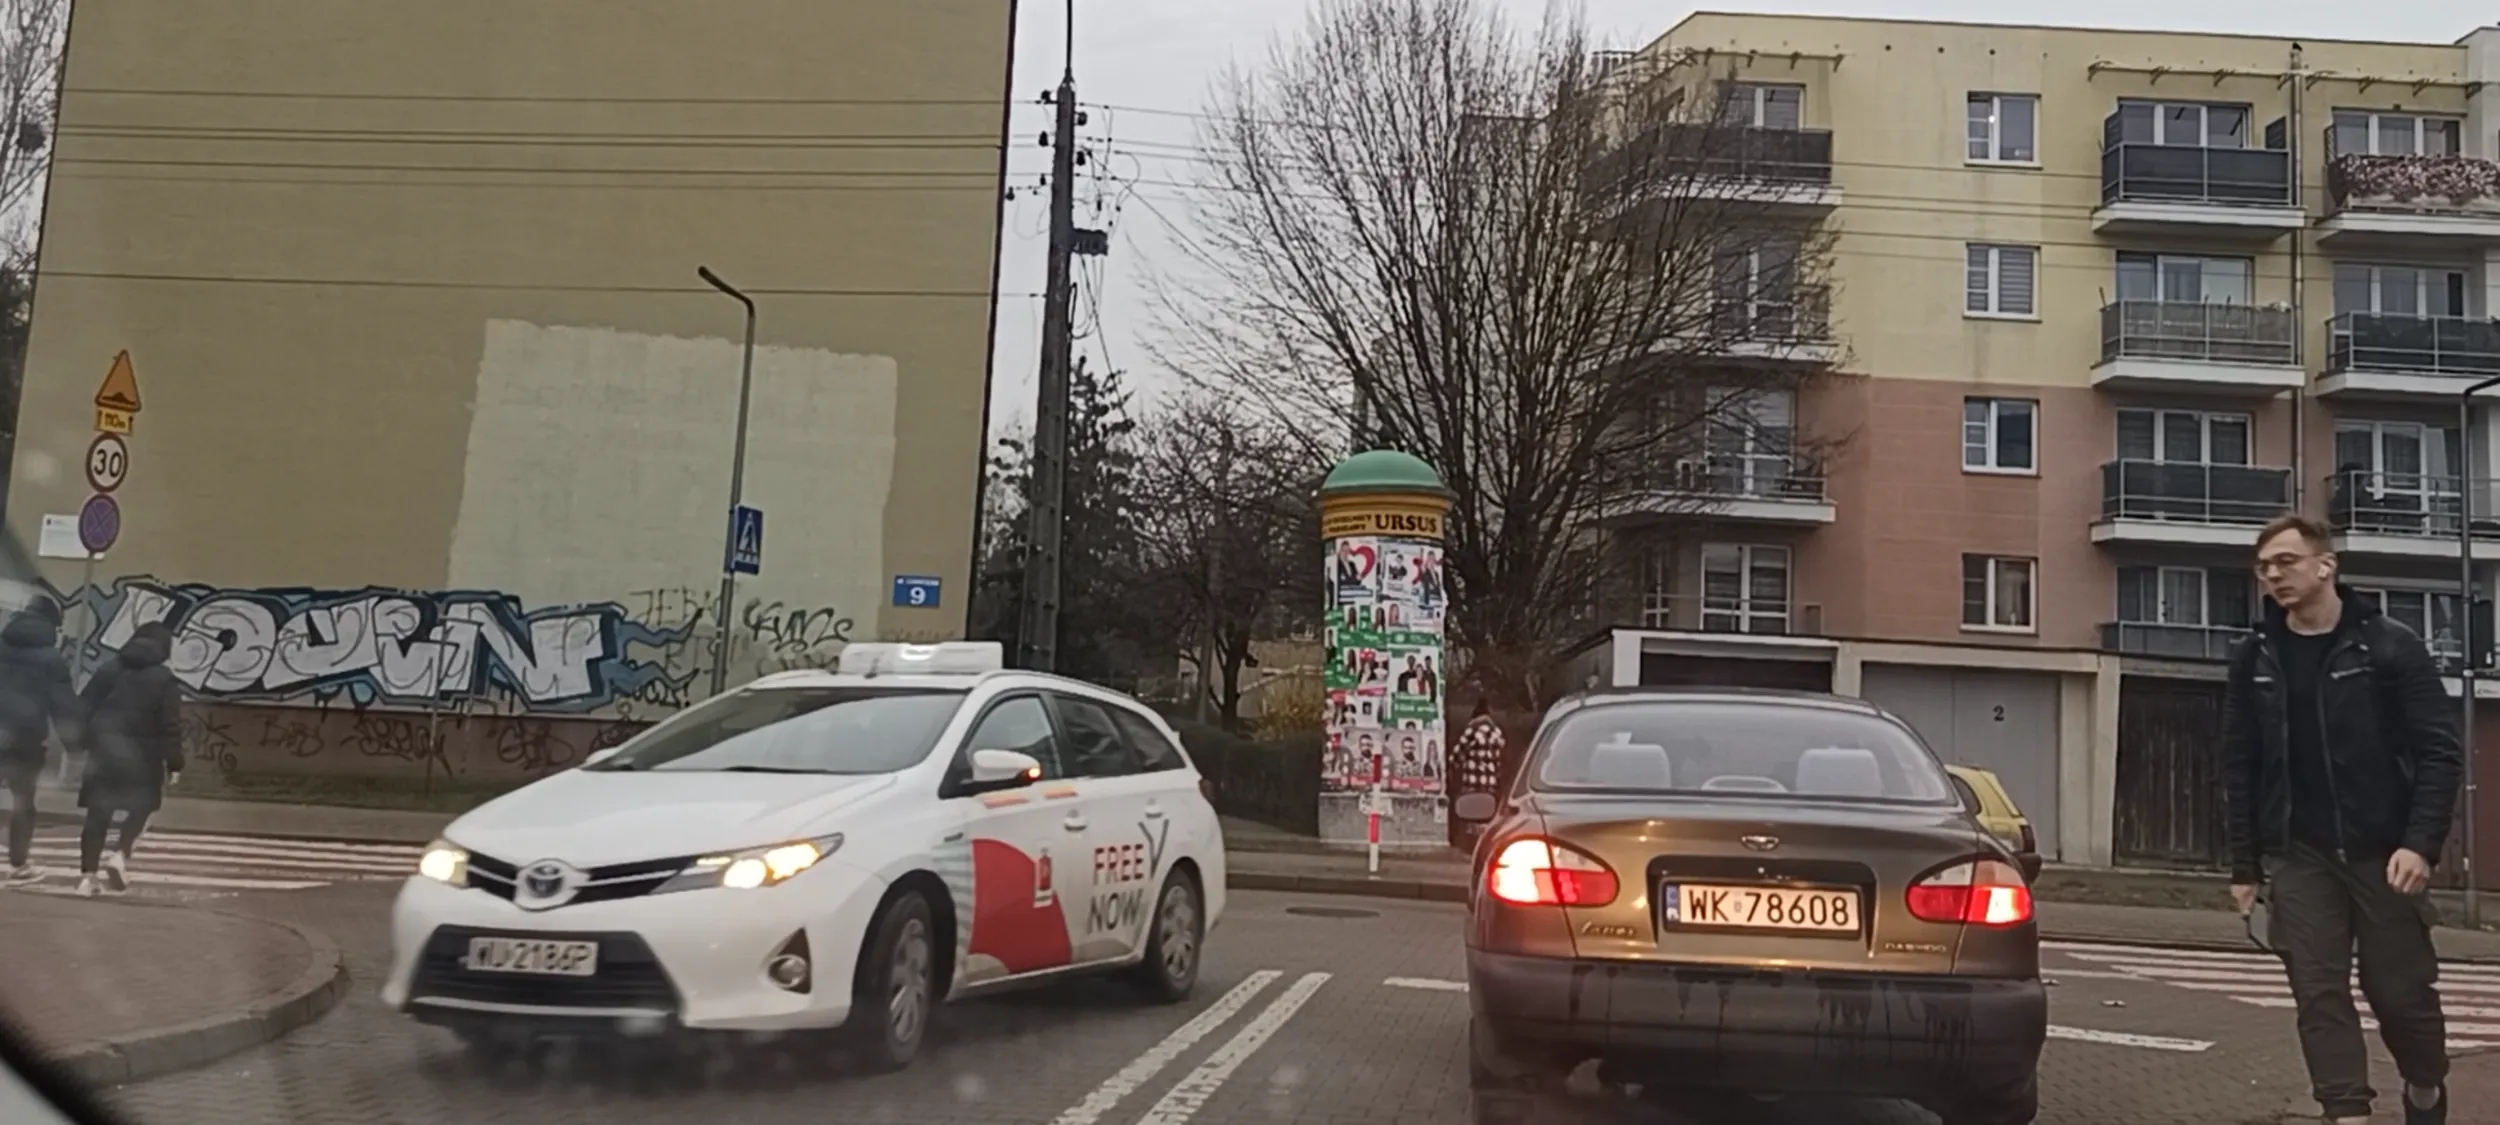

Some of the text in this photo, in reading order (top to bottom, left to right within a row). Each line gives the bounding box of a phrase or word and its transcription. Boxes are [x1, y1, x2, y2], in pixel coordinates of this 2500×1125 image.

[94, 448, 122, 478] 30
[1374, 514, 1437, 533] URSUS
[910, 587, 926, 605] 9
[1993, 705, 2004, 721] 2
[1093, 843, 1144, 886] FREE
[1087, 888, 1144, 935] NOW
[1688, 890, 1850, 926] WK 78608
